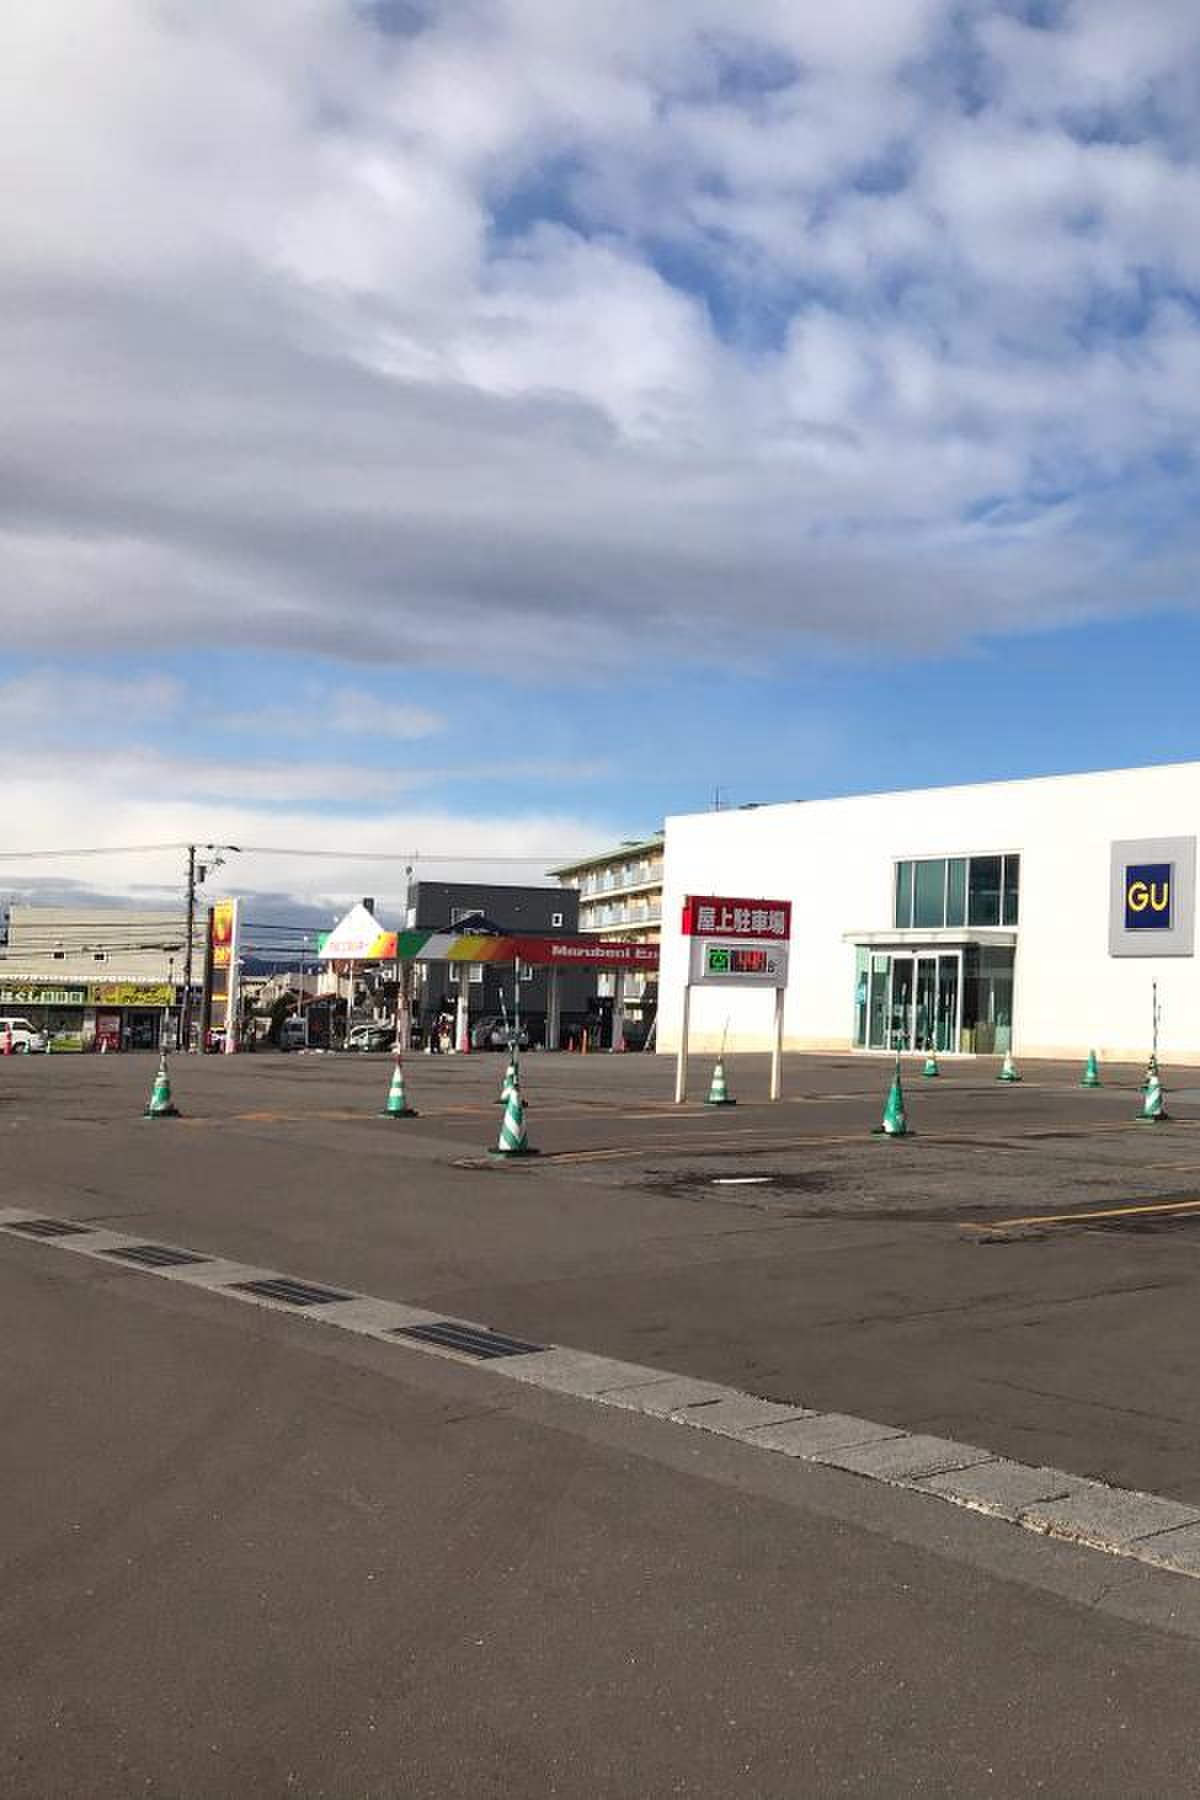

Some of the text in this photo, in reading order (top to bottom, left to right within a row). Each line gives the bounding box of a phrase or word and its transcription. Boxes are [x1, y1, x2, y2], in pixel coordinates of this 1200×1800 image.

[1128, 881, 1169, 912] GU
[698, 906, 785, 935] 屋上駐車場
